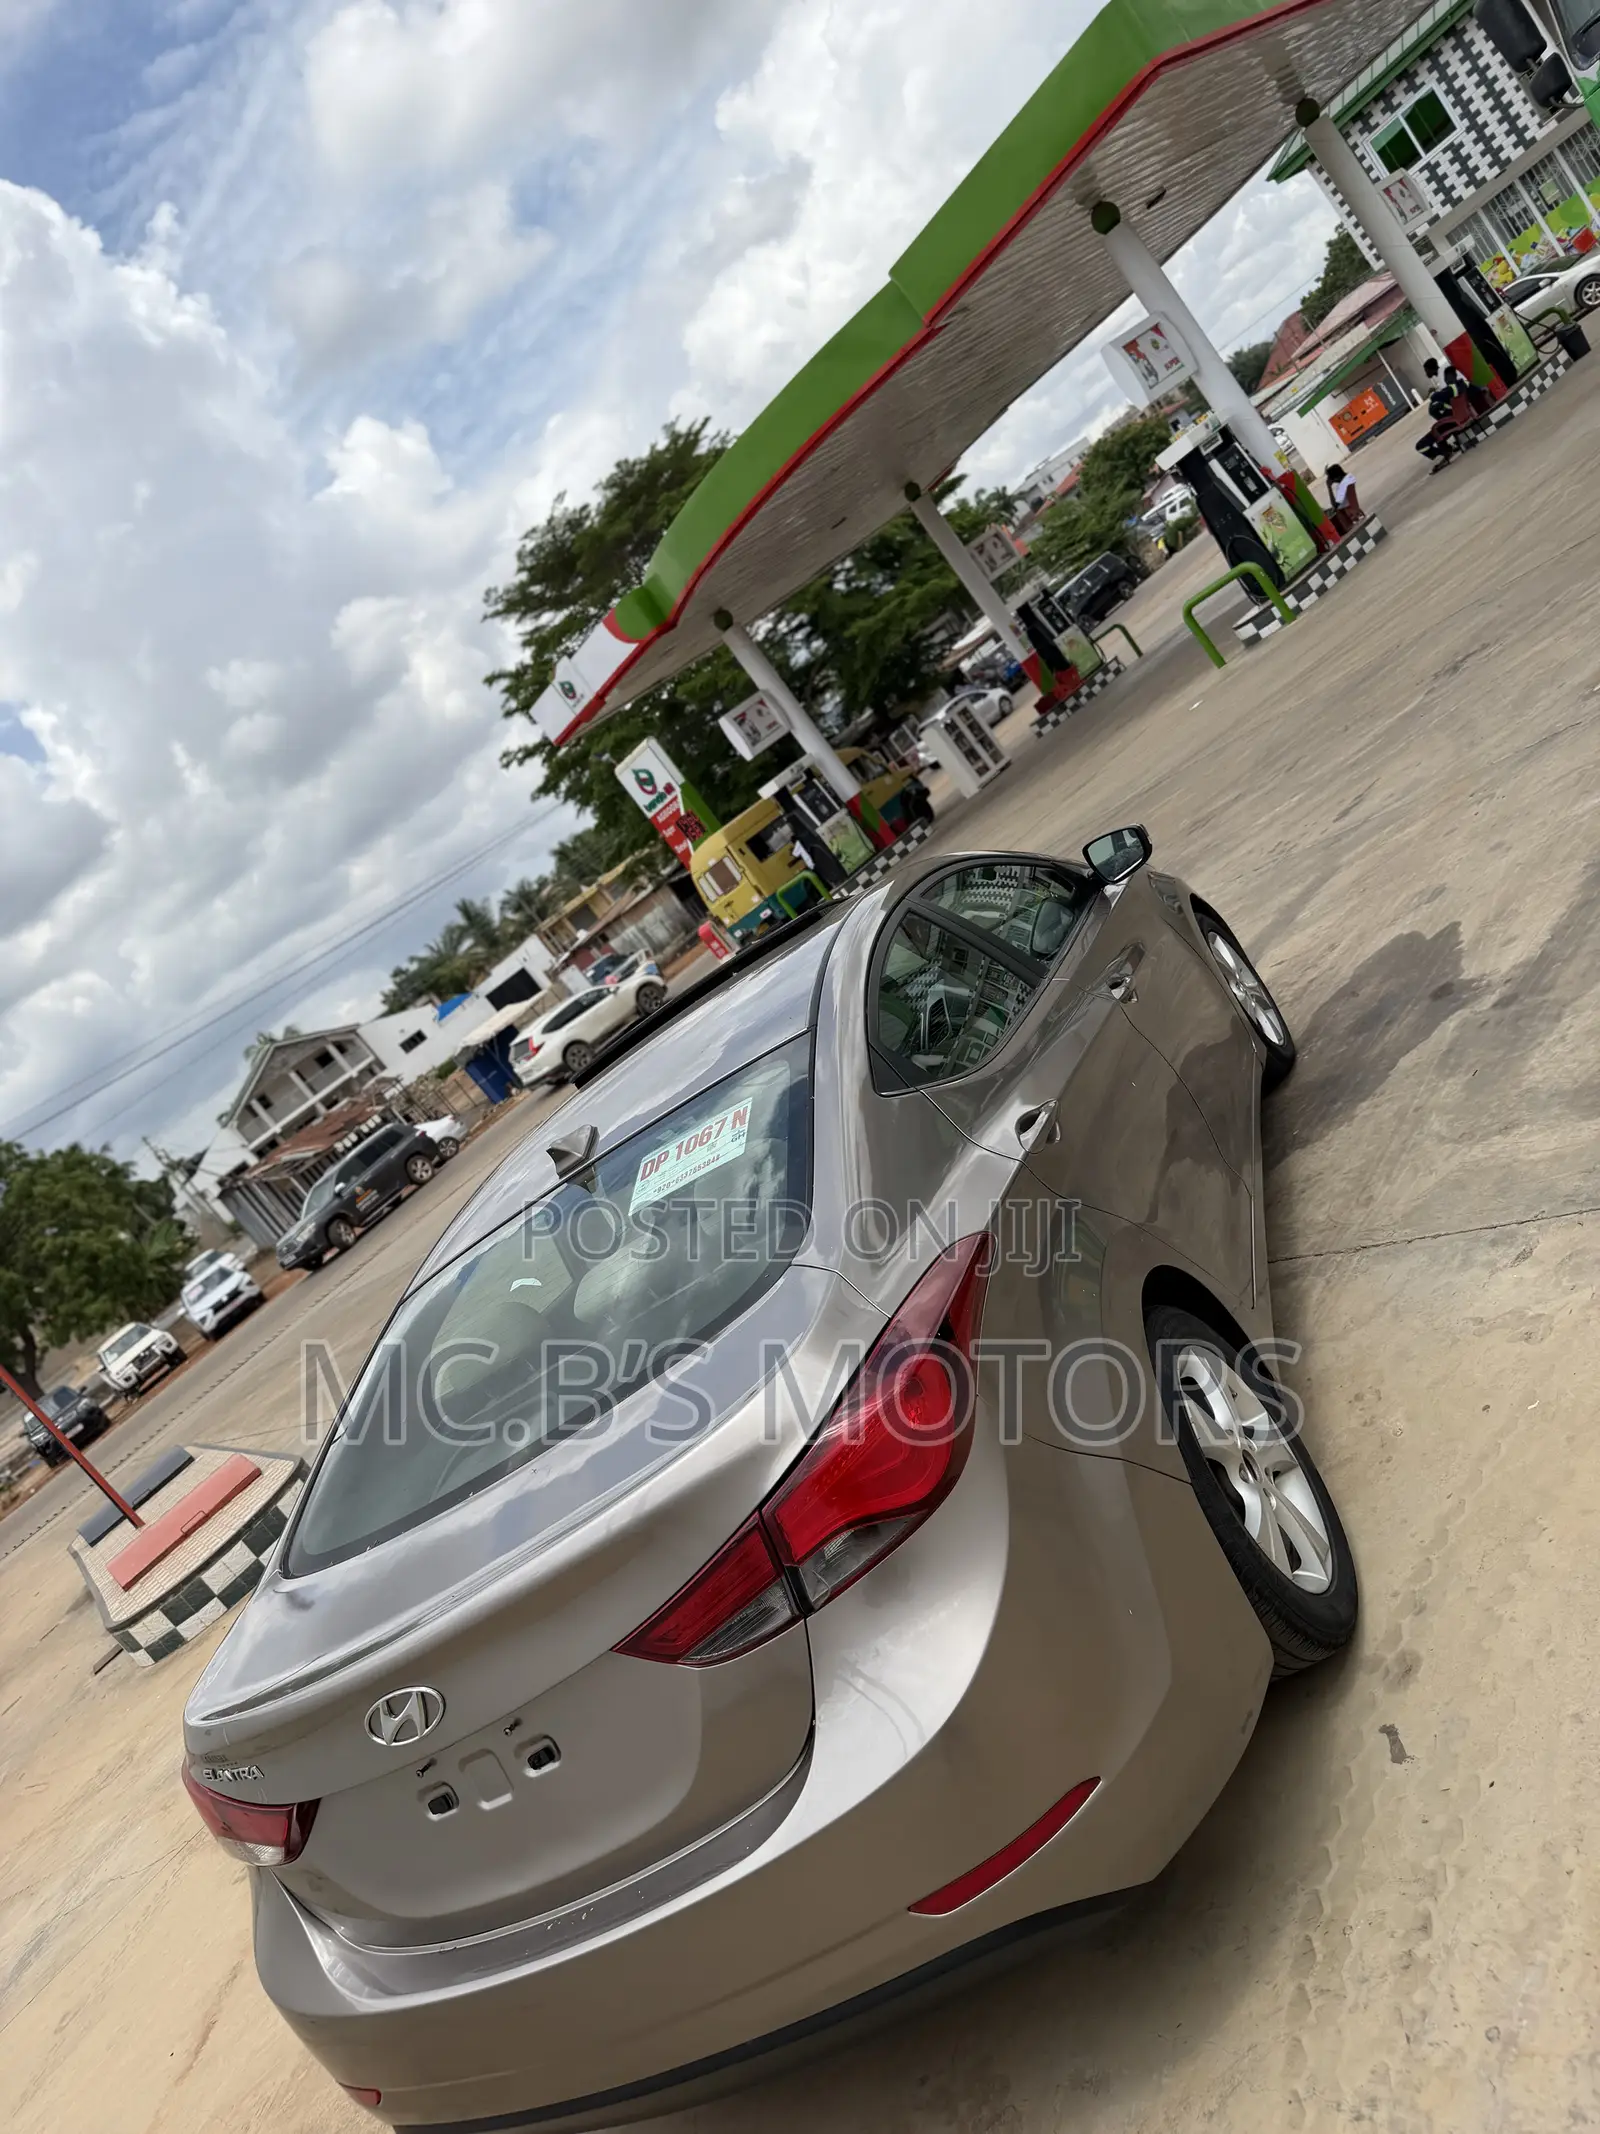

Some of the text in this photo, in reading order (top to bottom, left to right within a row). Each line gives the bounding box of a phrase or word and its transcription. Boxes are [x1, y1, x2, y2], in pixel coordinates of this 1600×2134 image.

[640, 1150, 669, 1182] DP
[675, 1116, 728, 1162] 1067
[731, 1106, 748, 1129] N
[203, 1764, 264, 1782] ELANTRA
